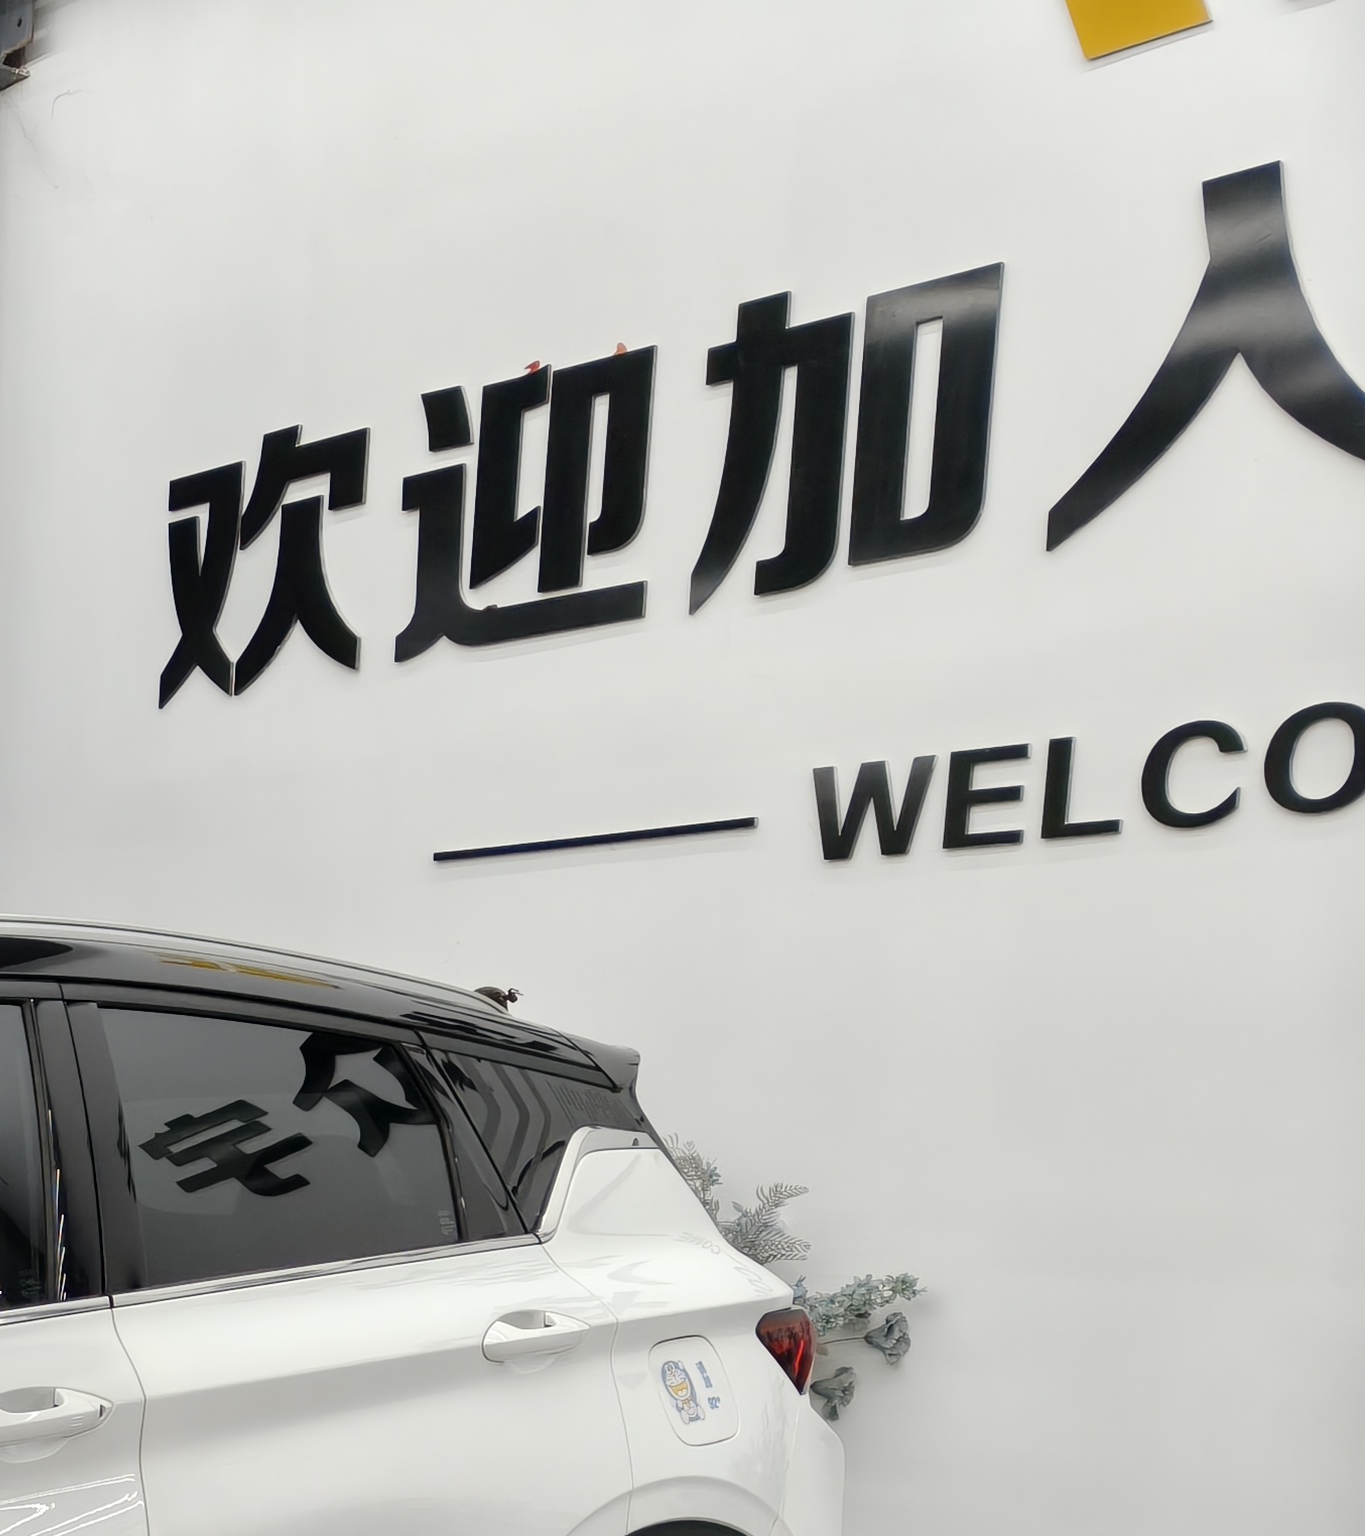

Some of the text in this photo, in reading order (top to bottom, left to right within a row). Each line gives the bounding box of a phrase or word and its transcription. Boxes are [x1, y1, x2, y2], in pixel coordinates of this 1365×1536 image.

[158, 160, 1365, 709] 欢迎加入
[812, 700, 1365, 864] WELCO
